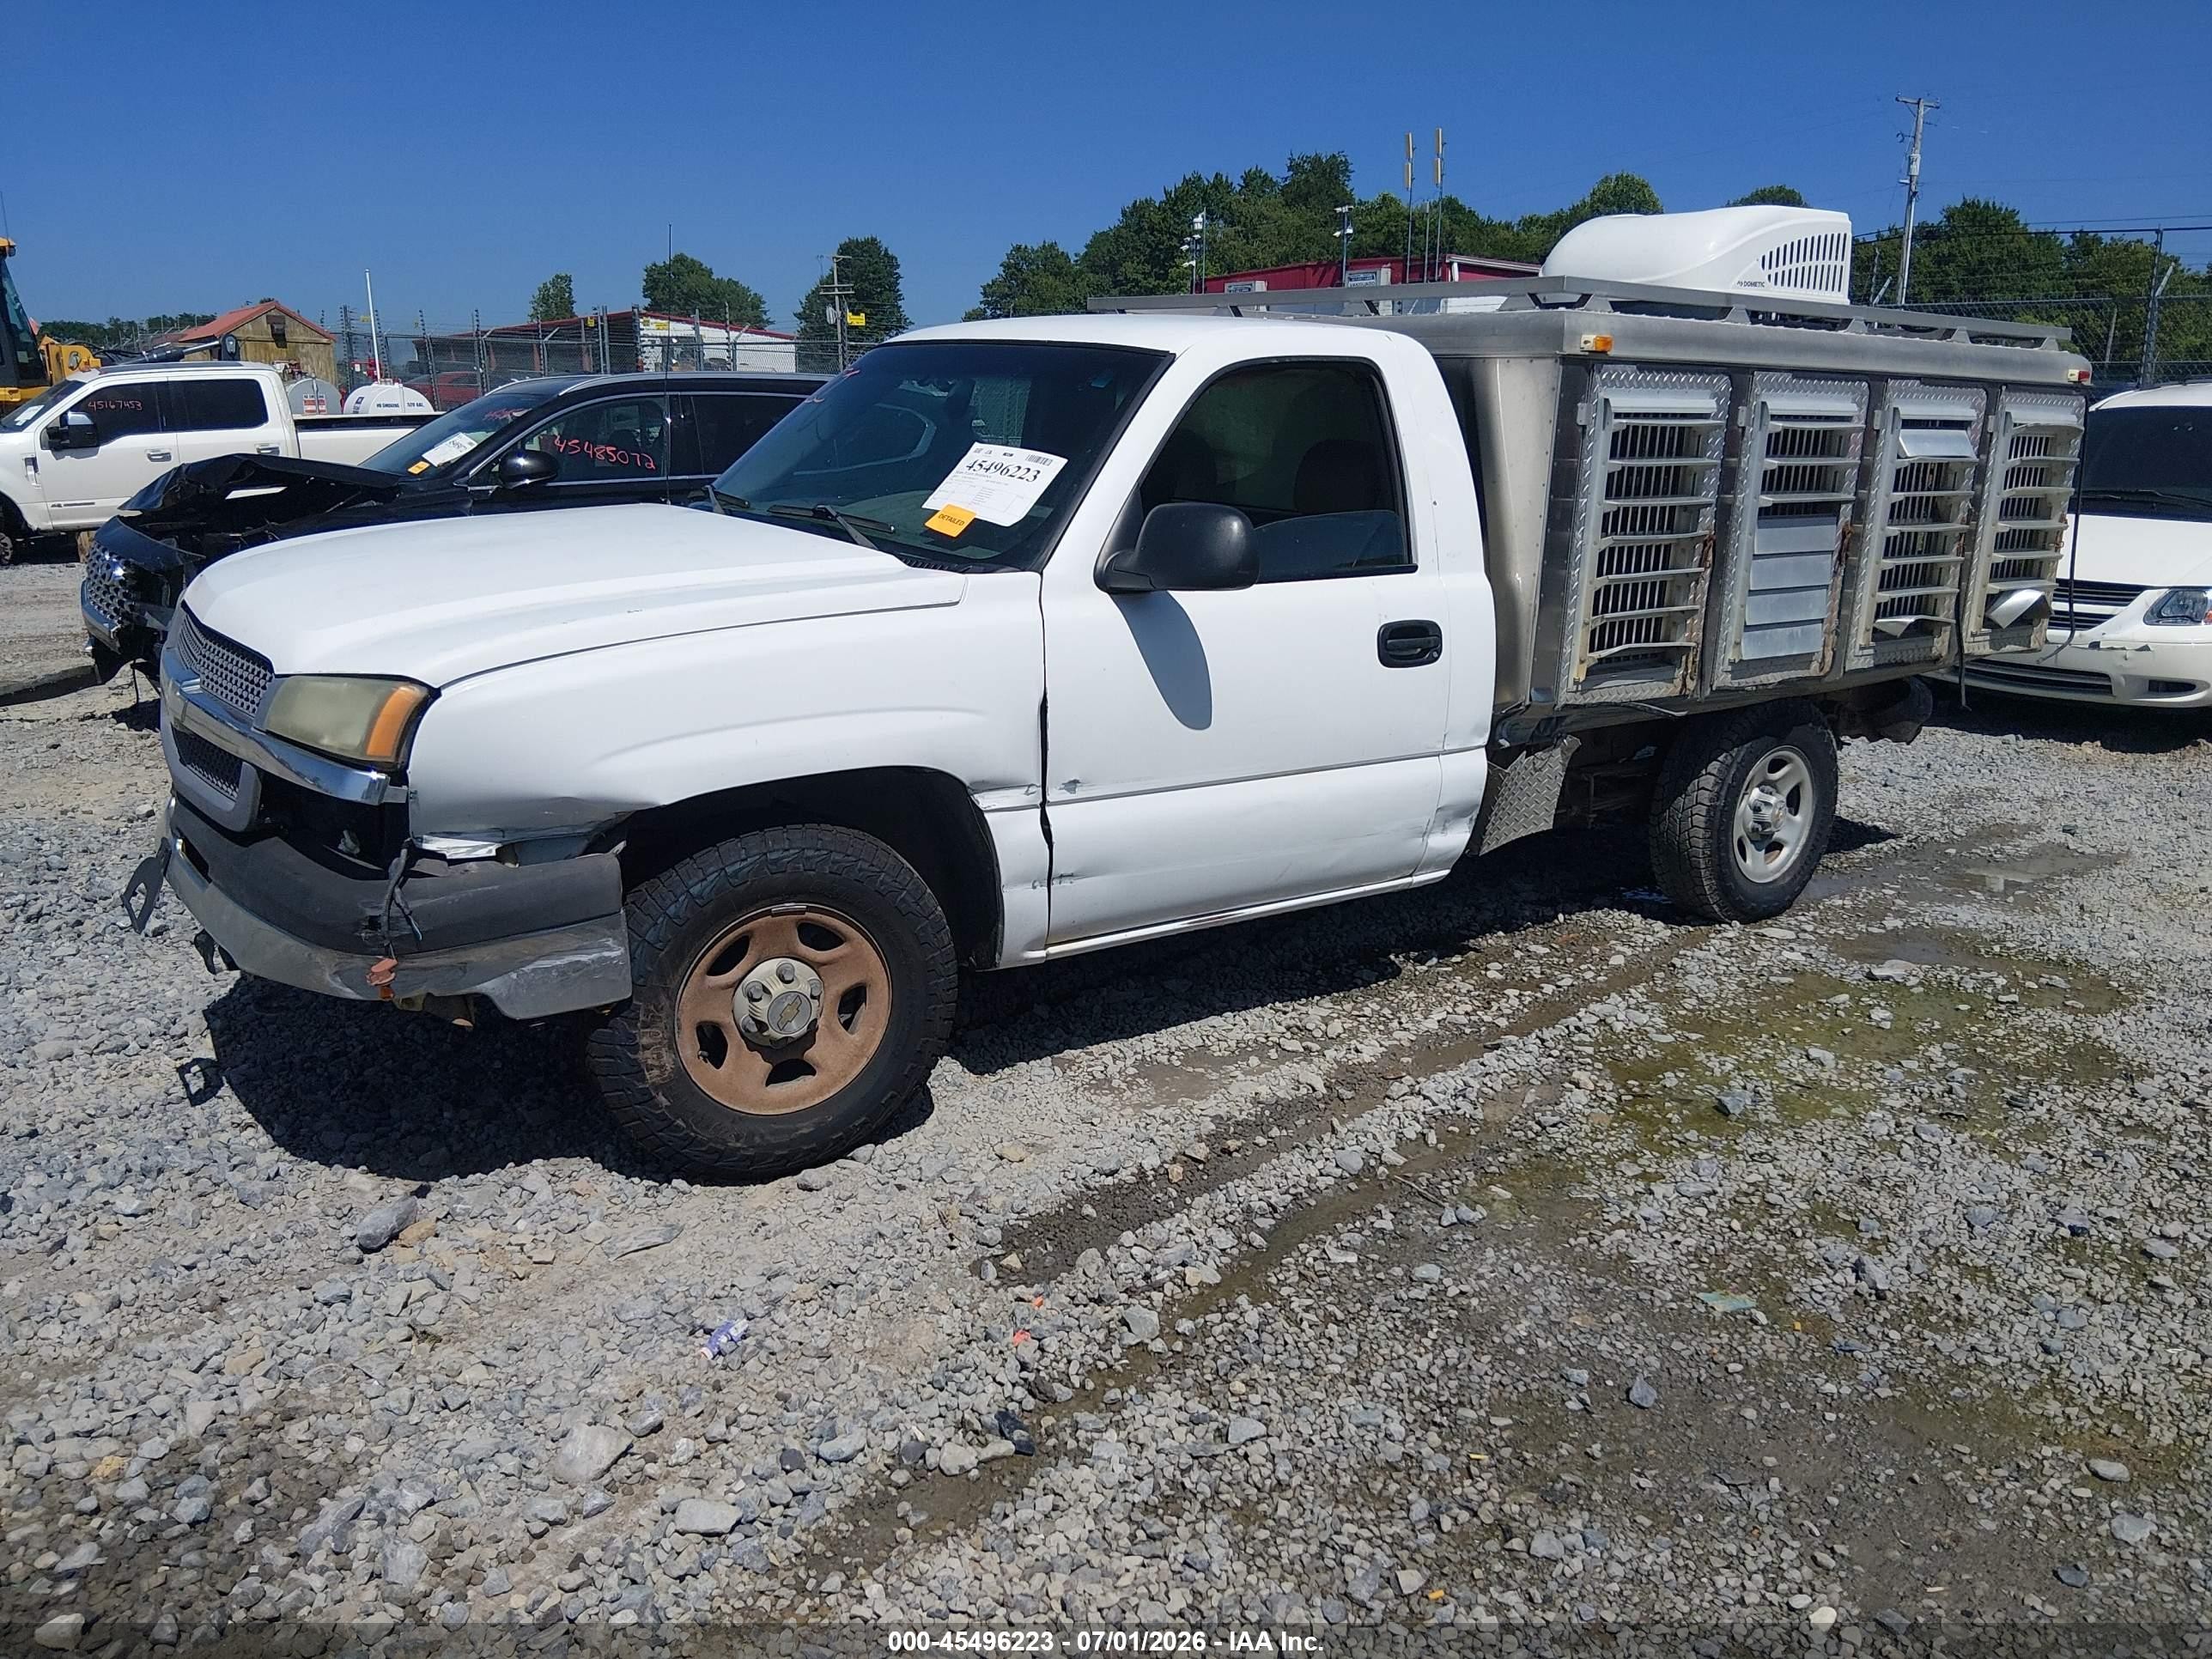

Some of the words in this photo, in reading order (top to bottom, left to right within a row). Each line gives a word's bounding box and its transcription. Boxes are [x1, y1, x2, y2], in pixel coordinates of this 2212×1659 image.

[554, 435, 656, 471] 45485072
[964, 459, 1042, 483] 45496223
[937, 513, 966, 527] DETAILED
